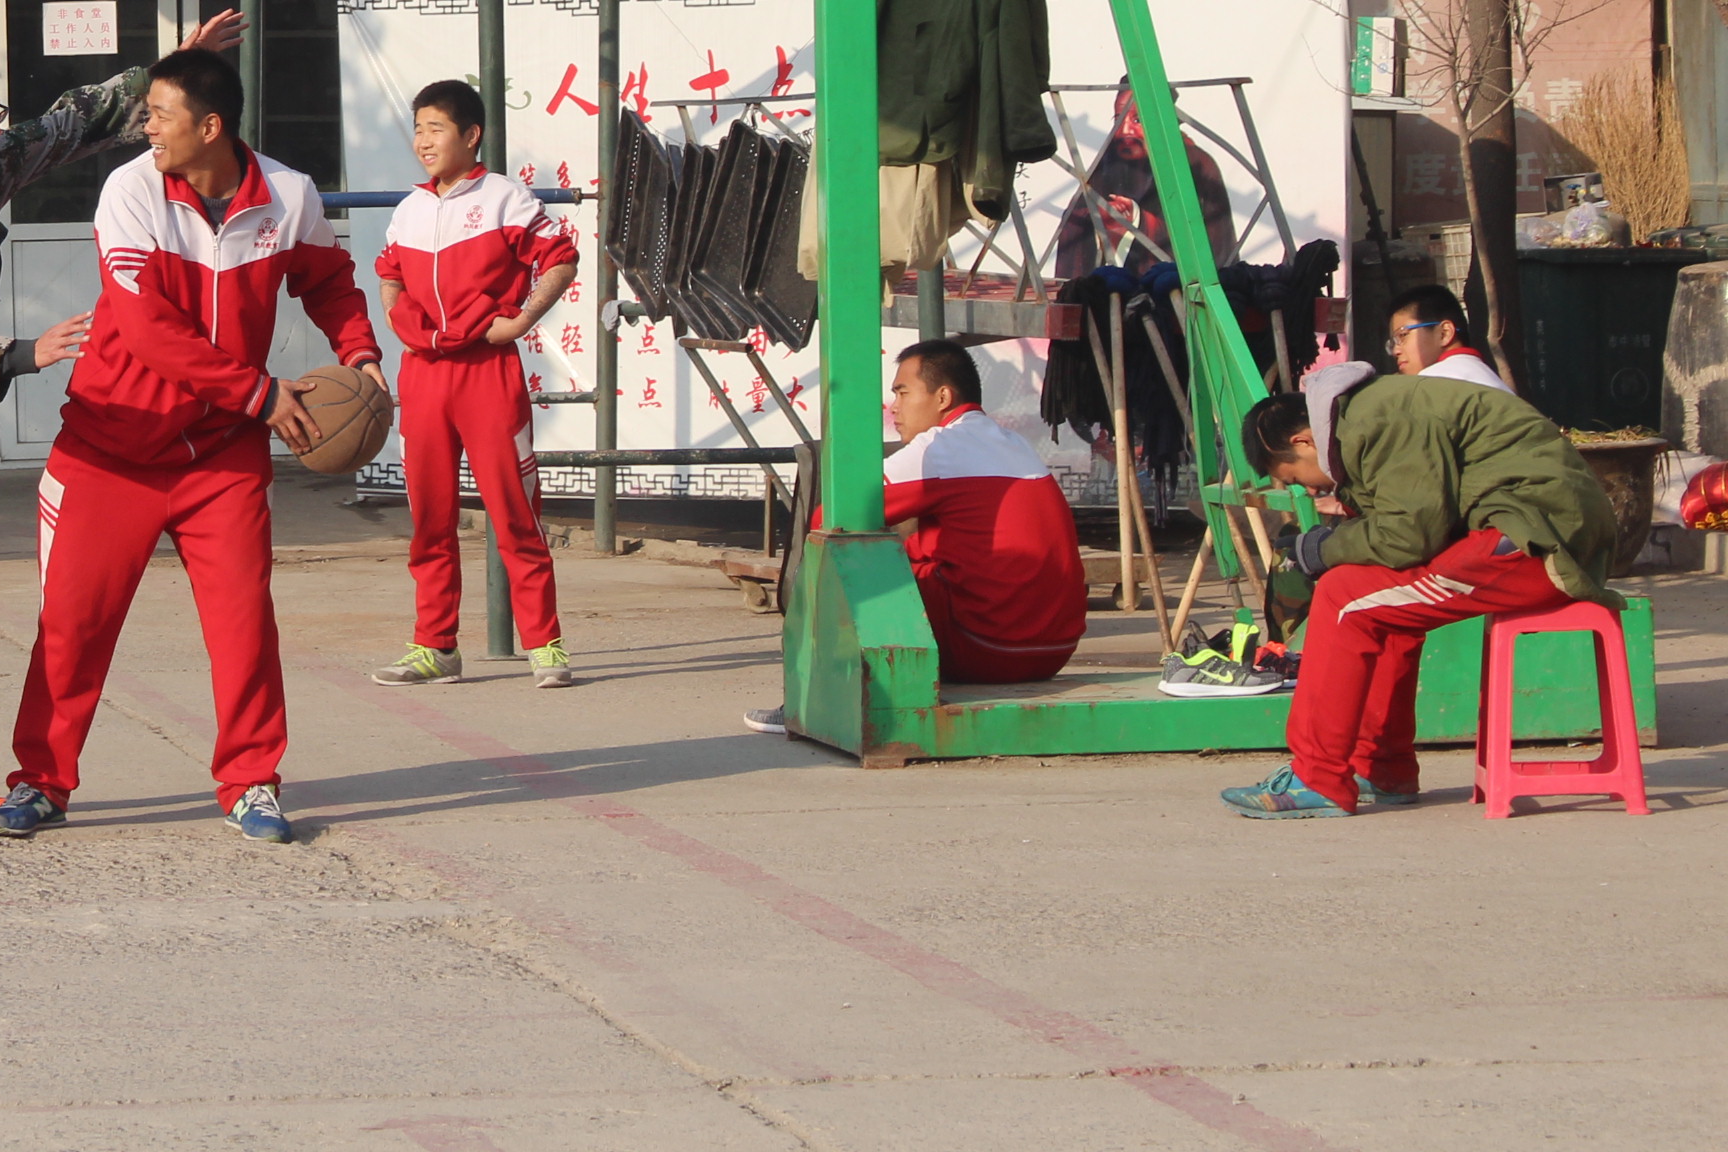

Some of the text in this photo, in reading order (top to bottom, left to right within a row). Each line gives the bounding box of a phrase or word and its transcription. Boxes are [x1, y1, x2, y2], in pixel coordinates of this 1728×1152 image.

[57, 8, 103, 19] 非食堂
[49, 22, 110, 34] 工作人员
[49, 37, 111, 49] 禁止入内
